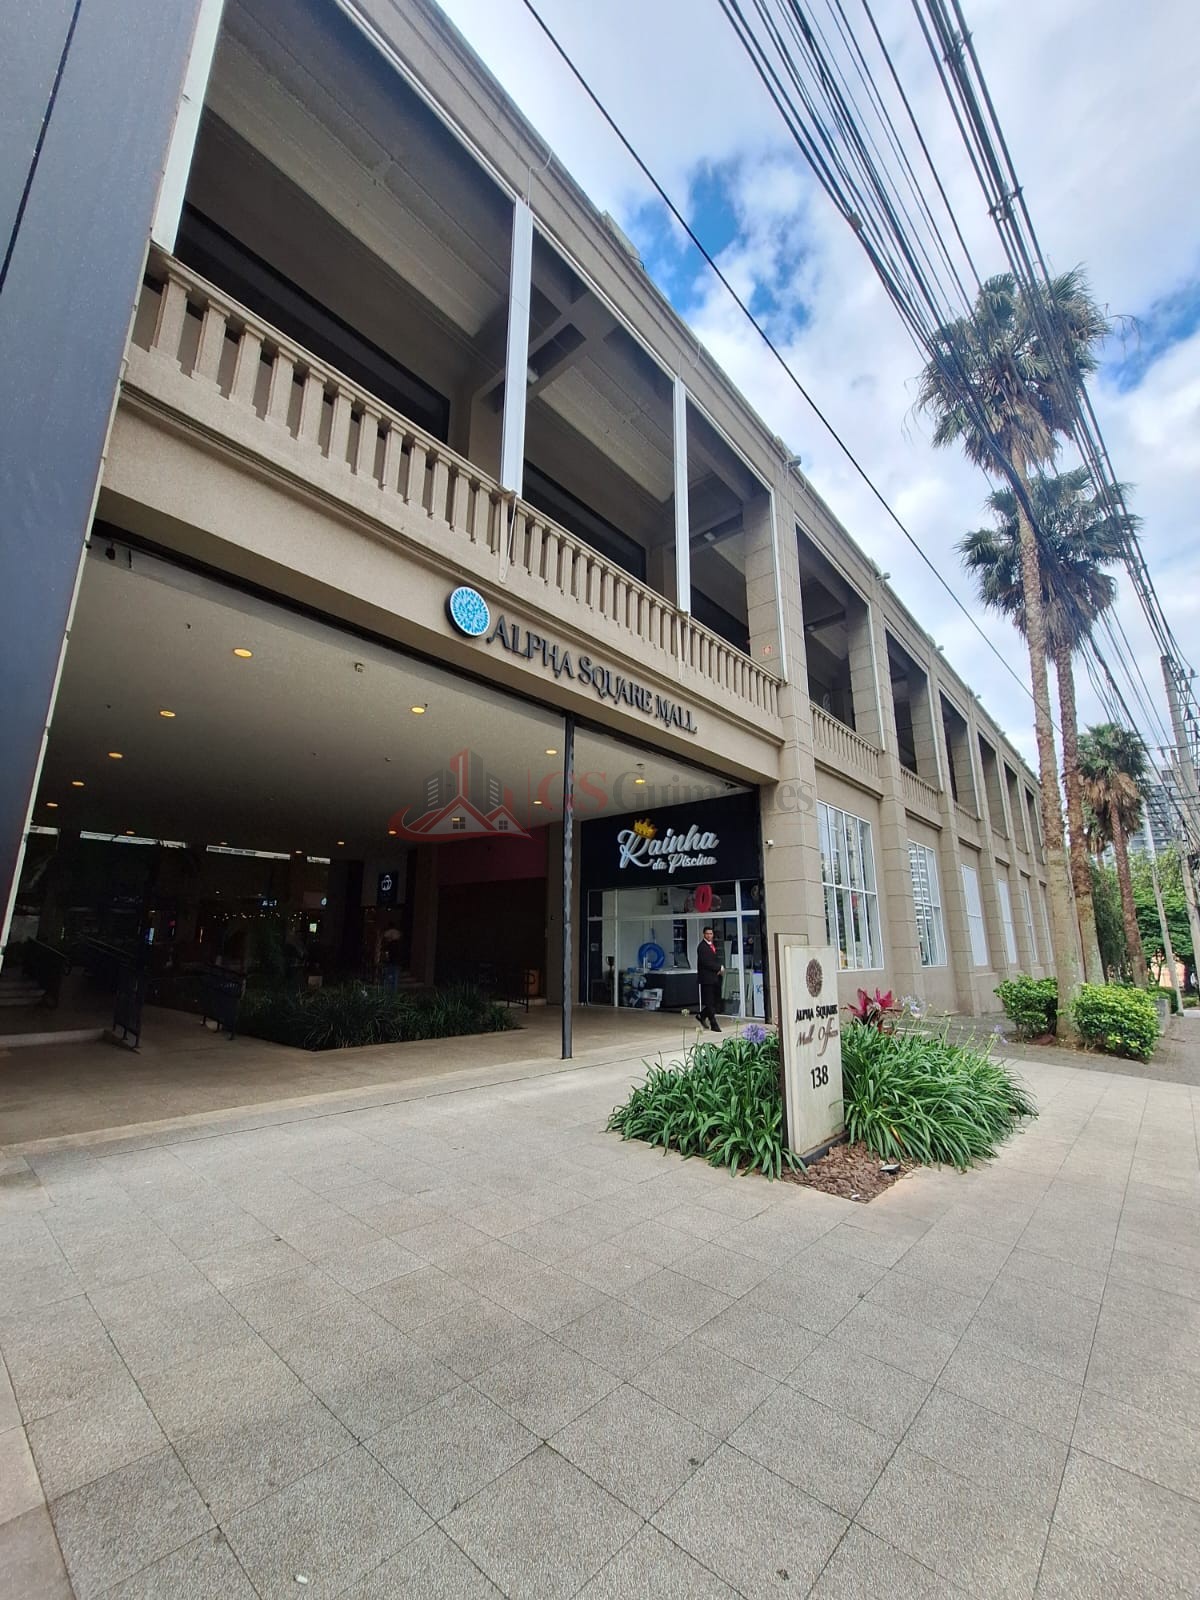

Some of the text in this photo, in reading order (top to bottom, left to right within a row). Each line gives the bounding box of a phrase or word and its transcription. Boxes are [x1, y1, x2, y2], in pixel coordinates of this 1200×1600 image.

[486, 614, 698, 734] ALPHA SQUARE MALL
[617, 824, 720, 869] Rainha
[652, 852, 717, 874] da Piscina
[795, 1004, 838, 1023] ALPHA SQUARE
[810, 1064, 829, 1089] 138
